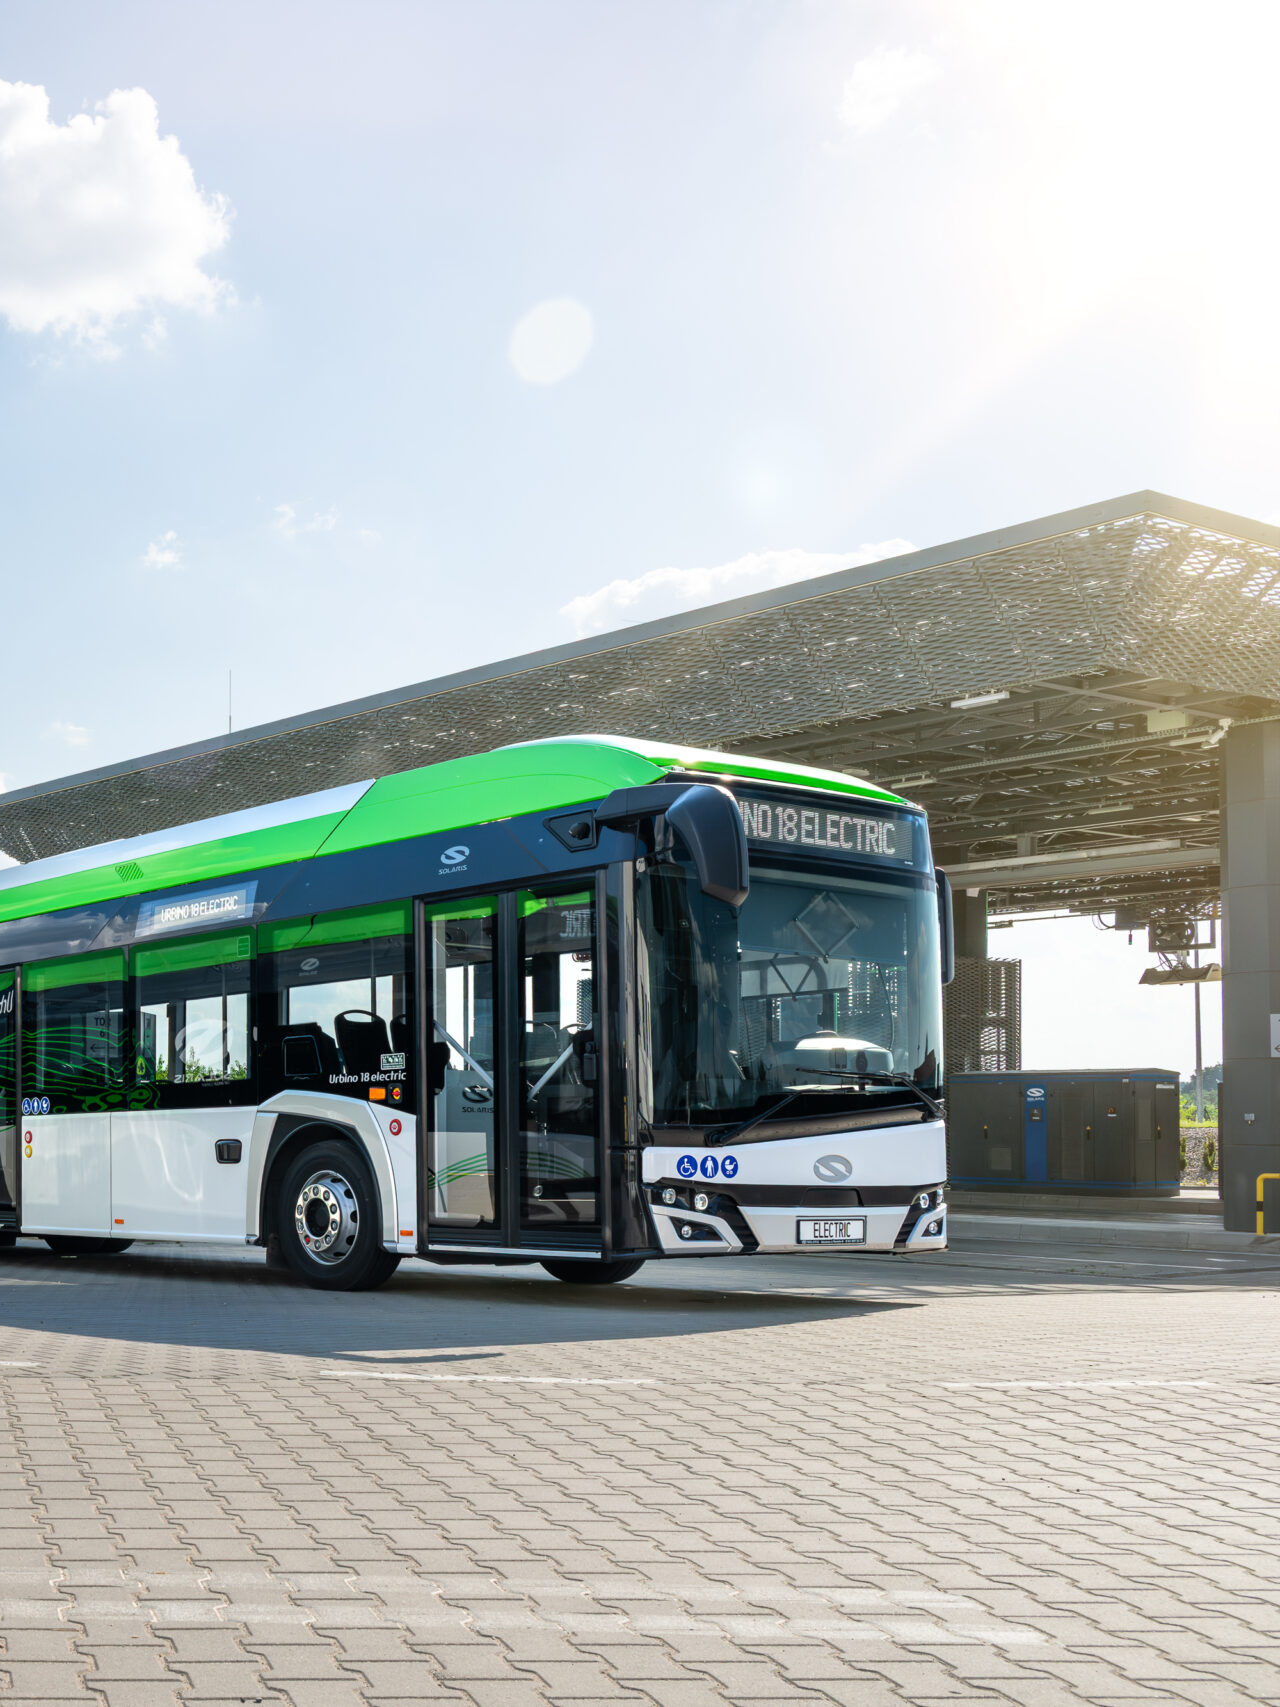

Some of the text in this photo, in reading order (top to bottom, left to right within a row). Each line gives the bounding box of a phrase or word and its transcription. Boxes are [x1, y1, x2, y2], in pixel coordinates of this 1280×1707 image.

[738, 801, 896, 855] INO 18 ELECTRIC
[438, 864, 468, 876] SOLARIS
[161, 895, 238, 922] URBINO 18 ELECTRIC
[329, 1070, 407, 1084] Urbino 18 electric
[813, 1222, 851, 1239] ELECTRIC
